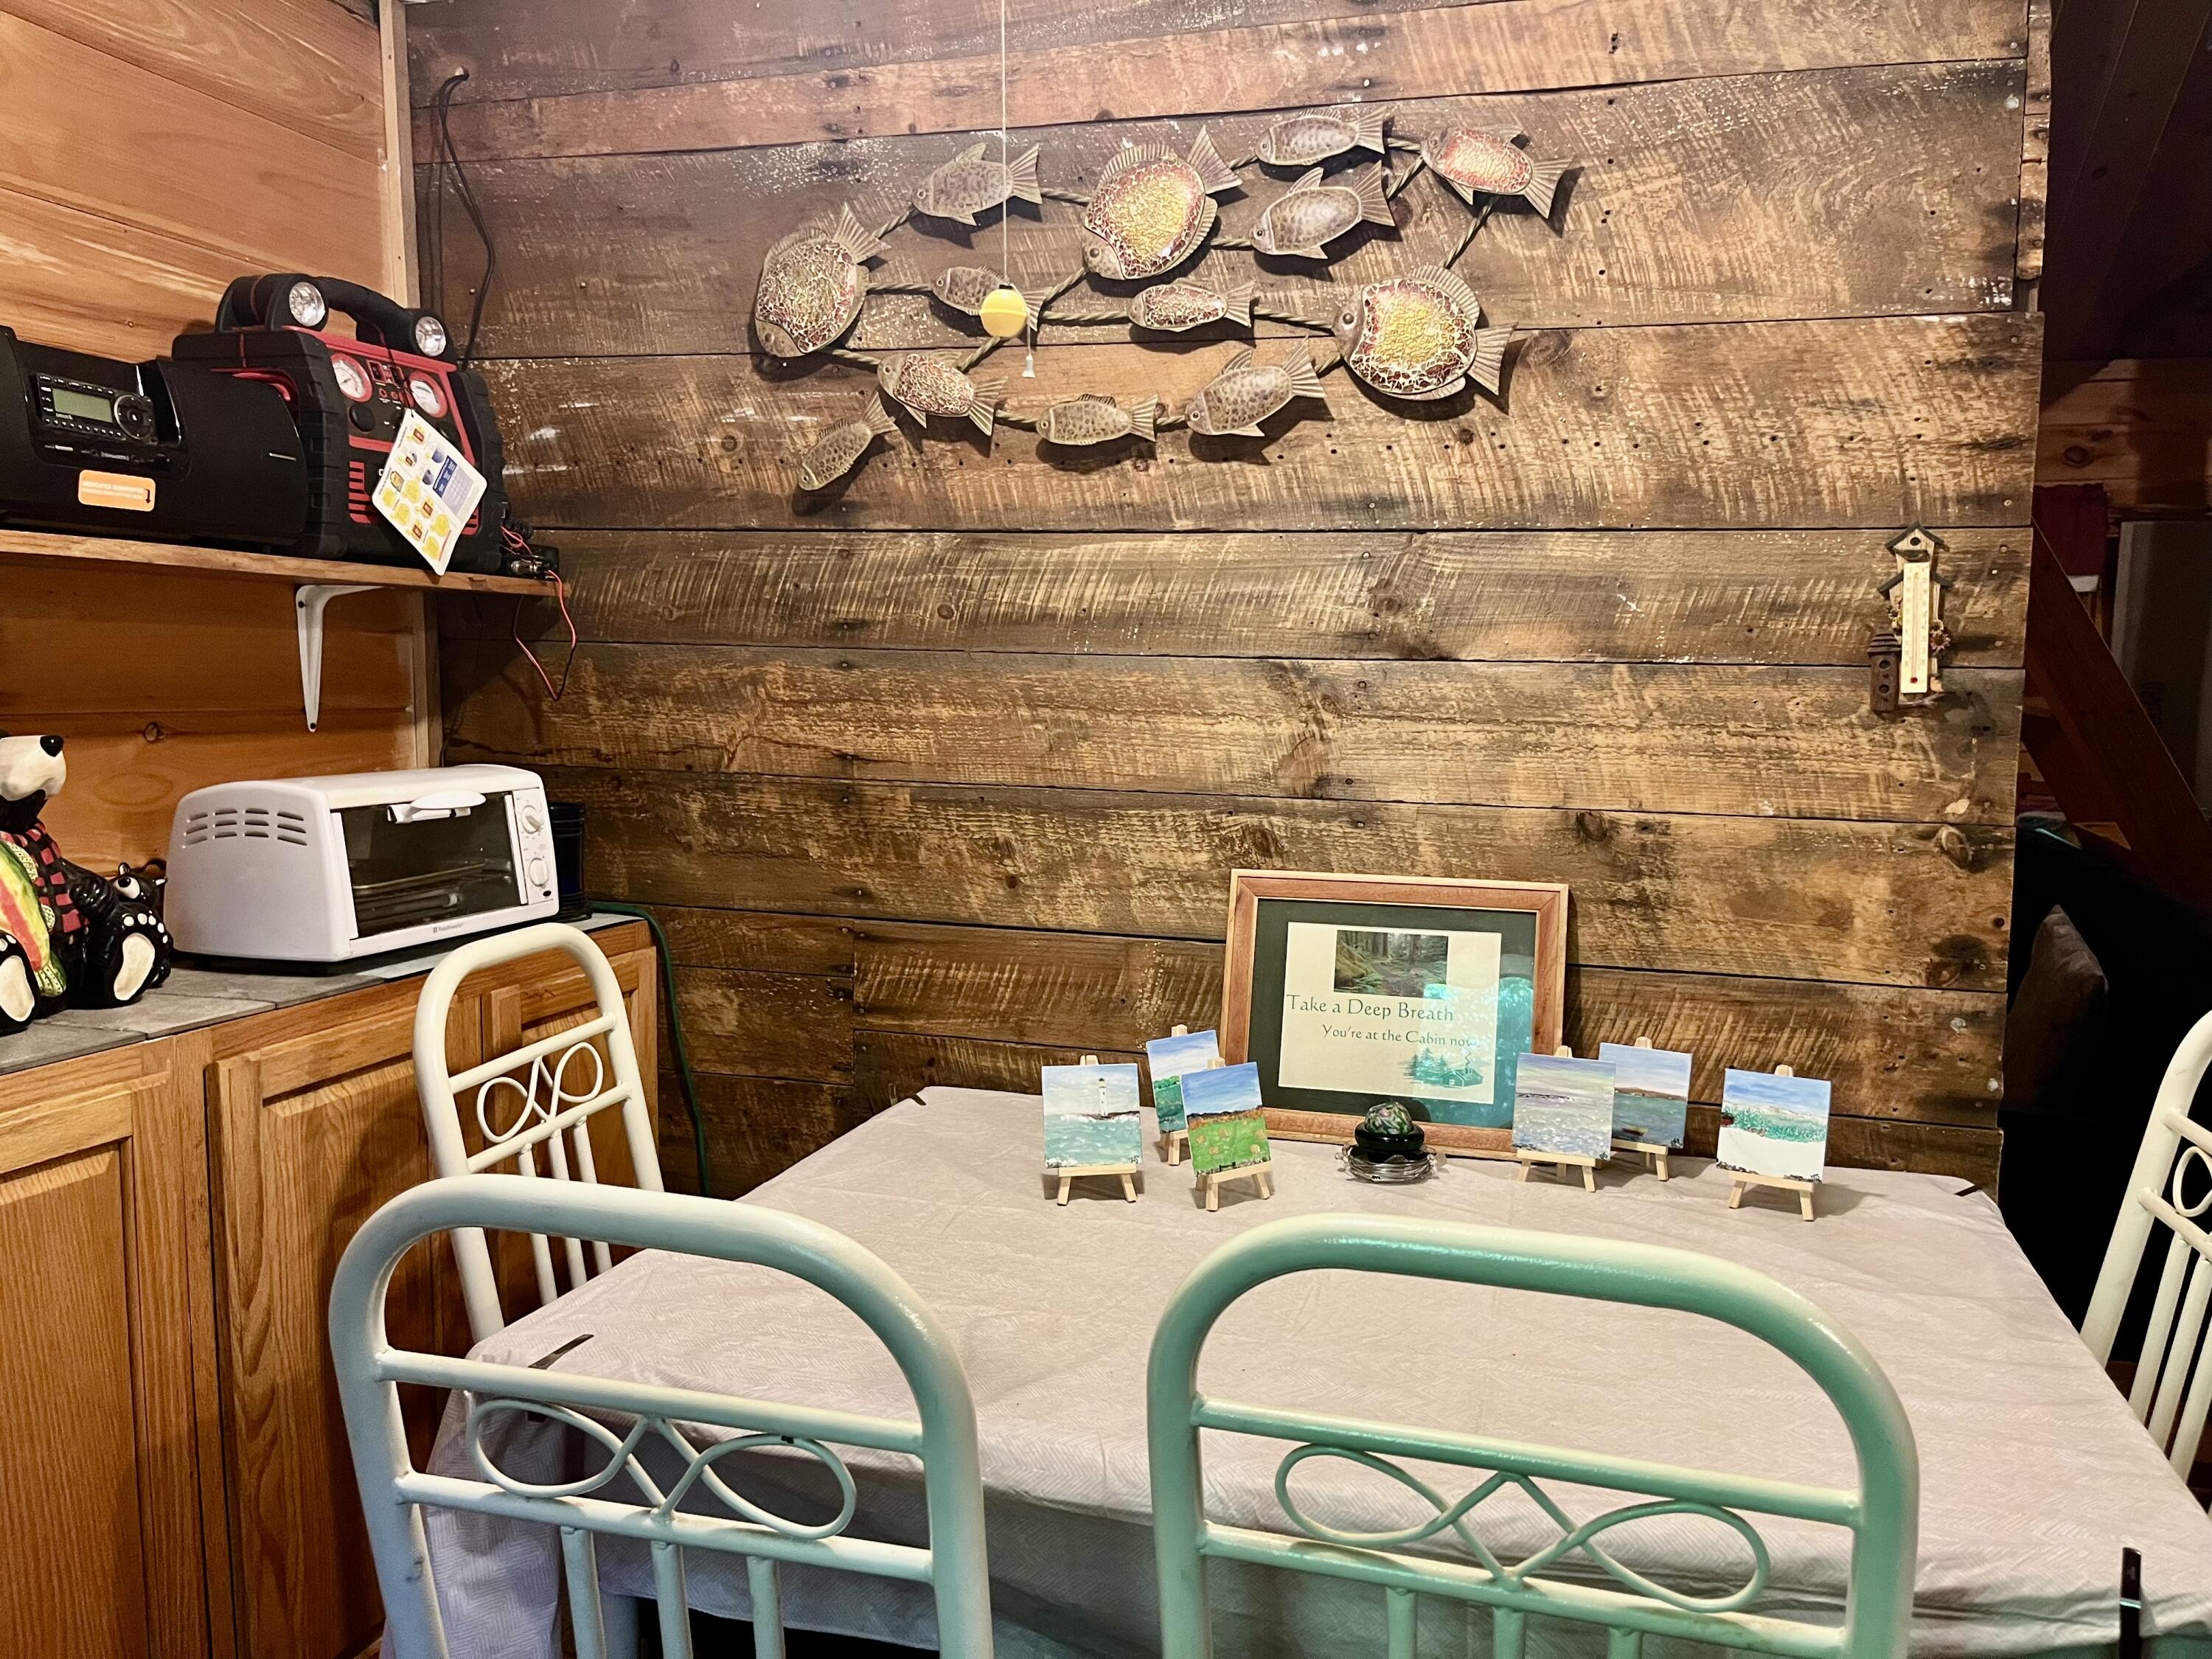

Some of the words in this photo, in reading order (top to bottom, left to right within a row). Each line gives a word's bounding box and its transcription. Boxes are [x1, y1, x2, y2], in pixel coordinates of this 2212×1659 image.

[1286, 994, 1327, 1012] Take
[1332, 1003, 1340, 1013] a
[1346, 998, 1391, 1020] Deep
[1397, 1001, 1453, 1021] Breath
[1322, 1024, 1362, 1038] You're
[1366, 1031, 1378, 1040] at
[1382, 1029, 1402, 1042] the
[1405, 1030, 1445, 1045] Cabin
